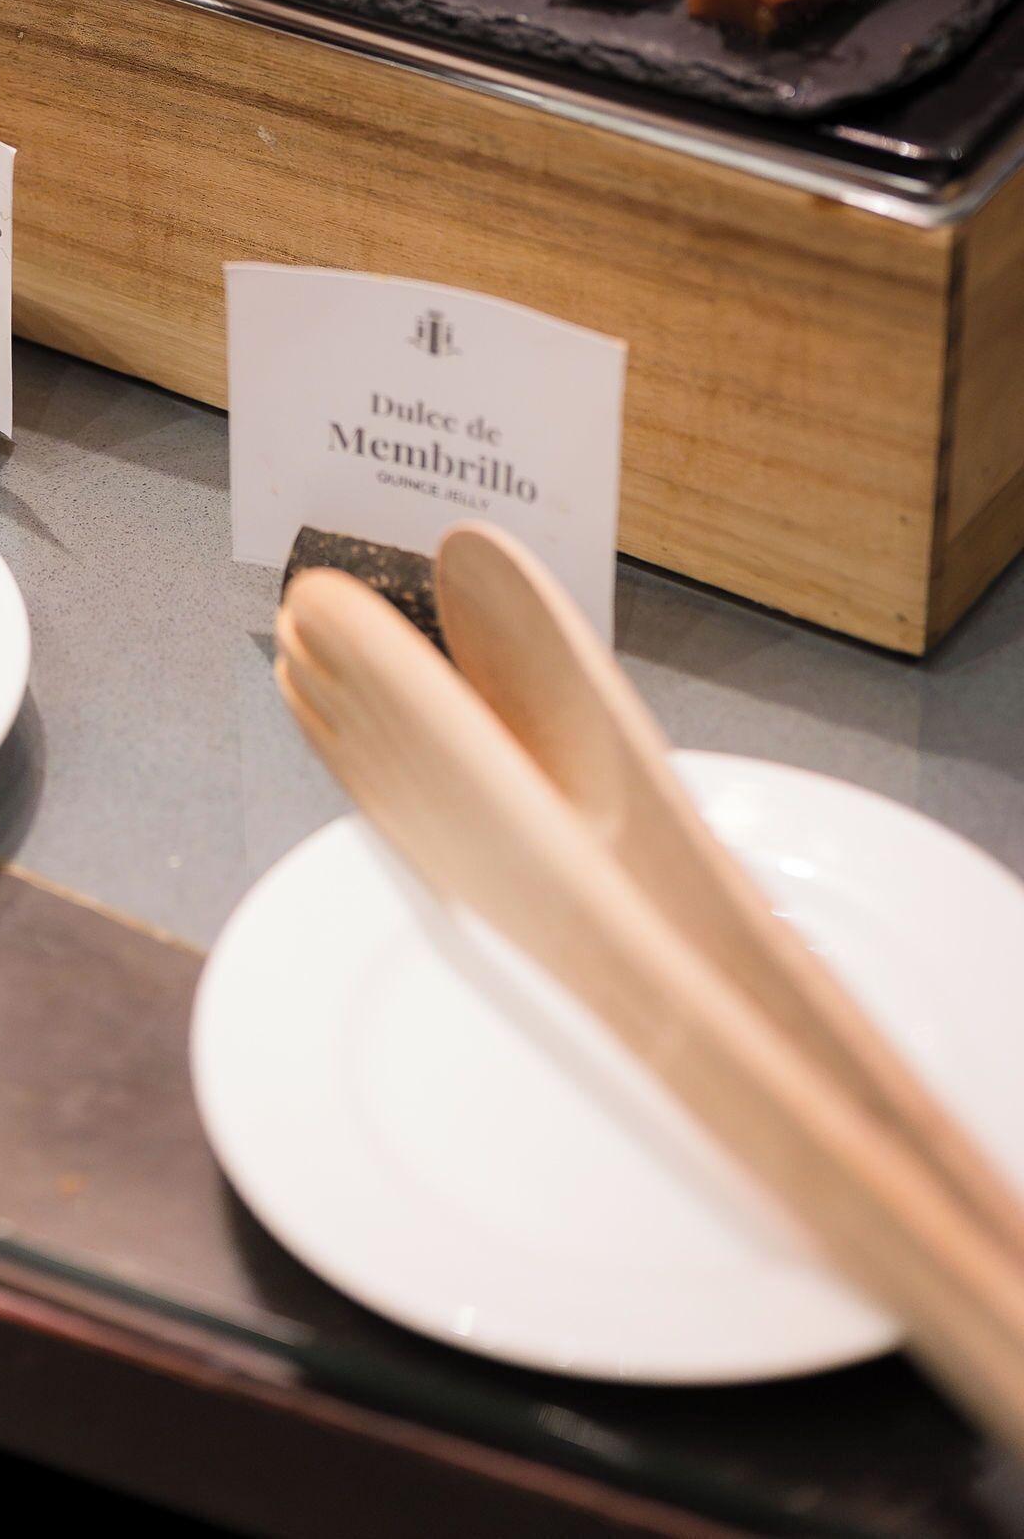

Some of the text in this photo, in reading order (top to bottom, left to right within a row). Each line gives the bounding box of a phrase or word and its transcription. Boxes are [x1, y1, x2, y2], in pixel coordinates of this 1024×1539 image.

[370, 390, 503, 448] Dulce de
[327, 421, 538, 505] Membrillo
[377, 470, 441, 499] QUINCE
